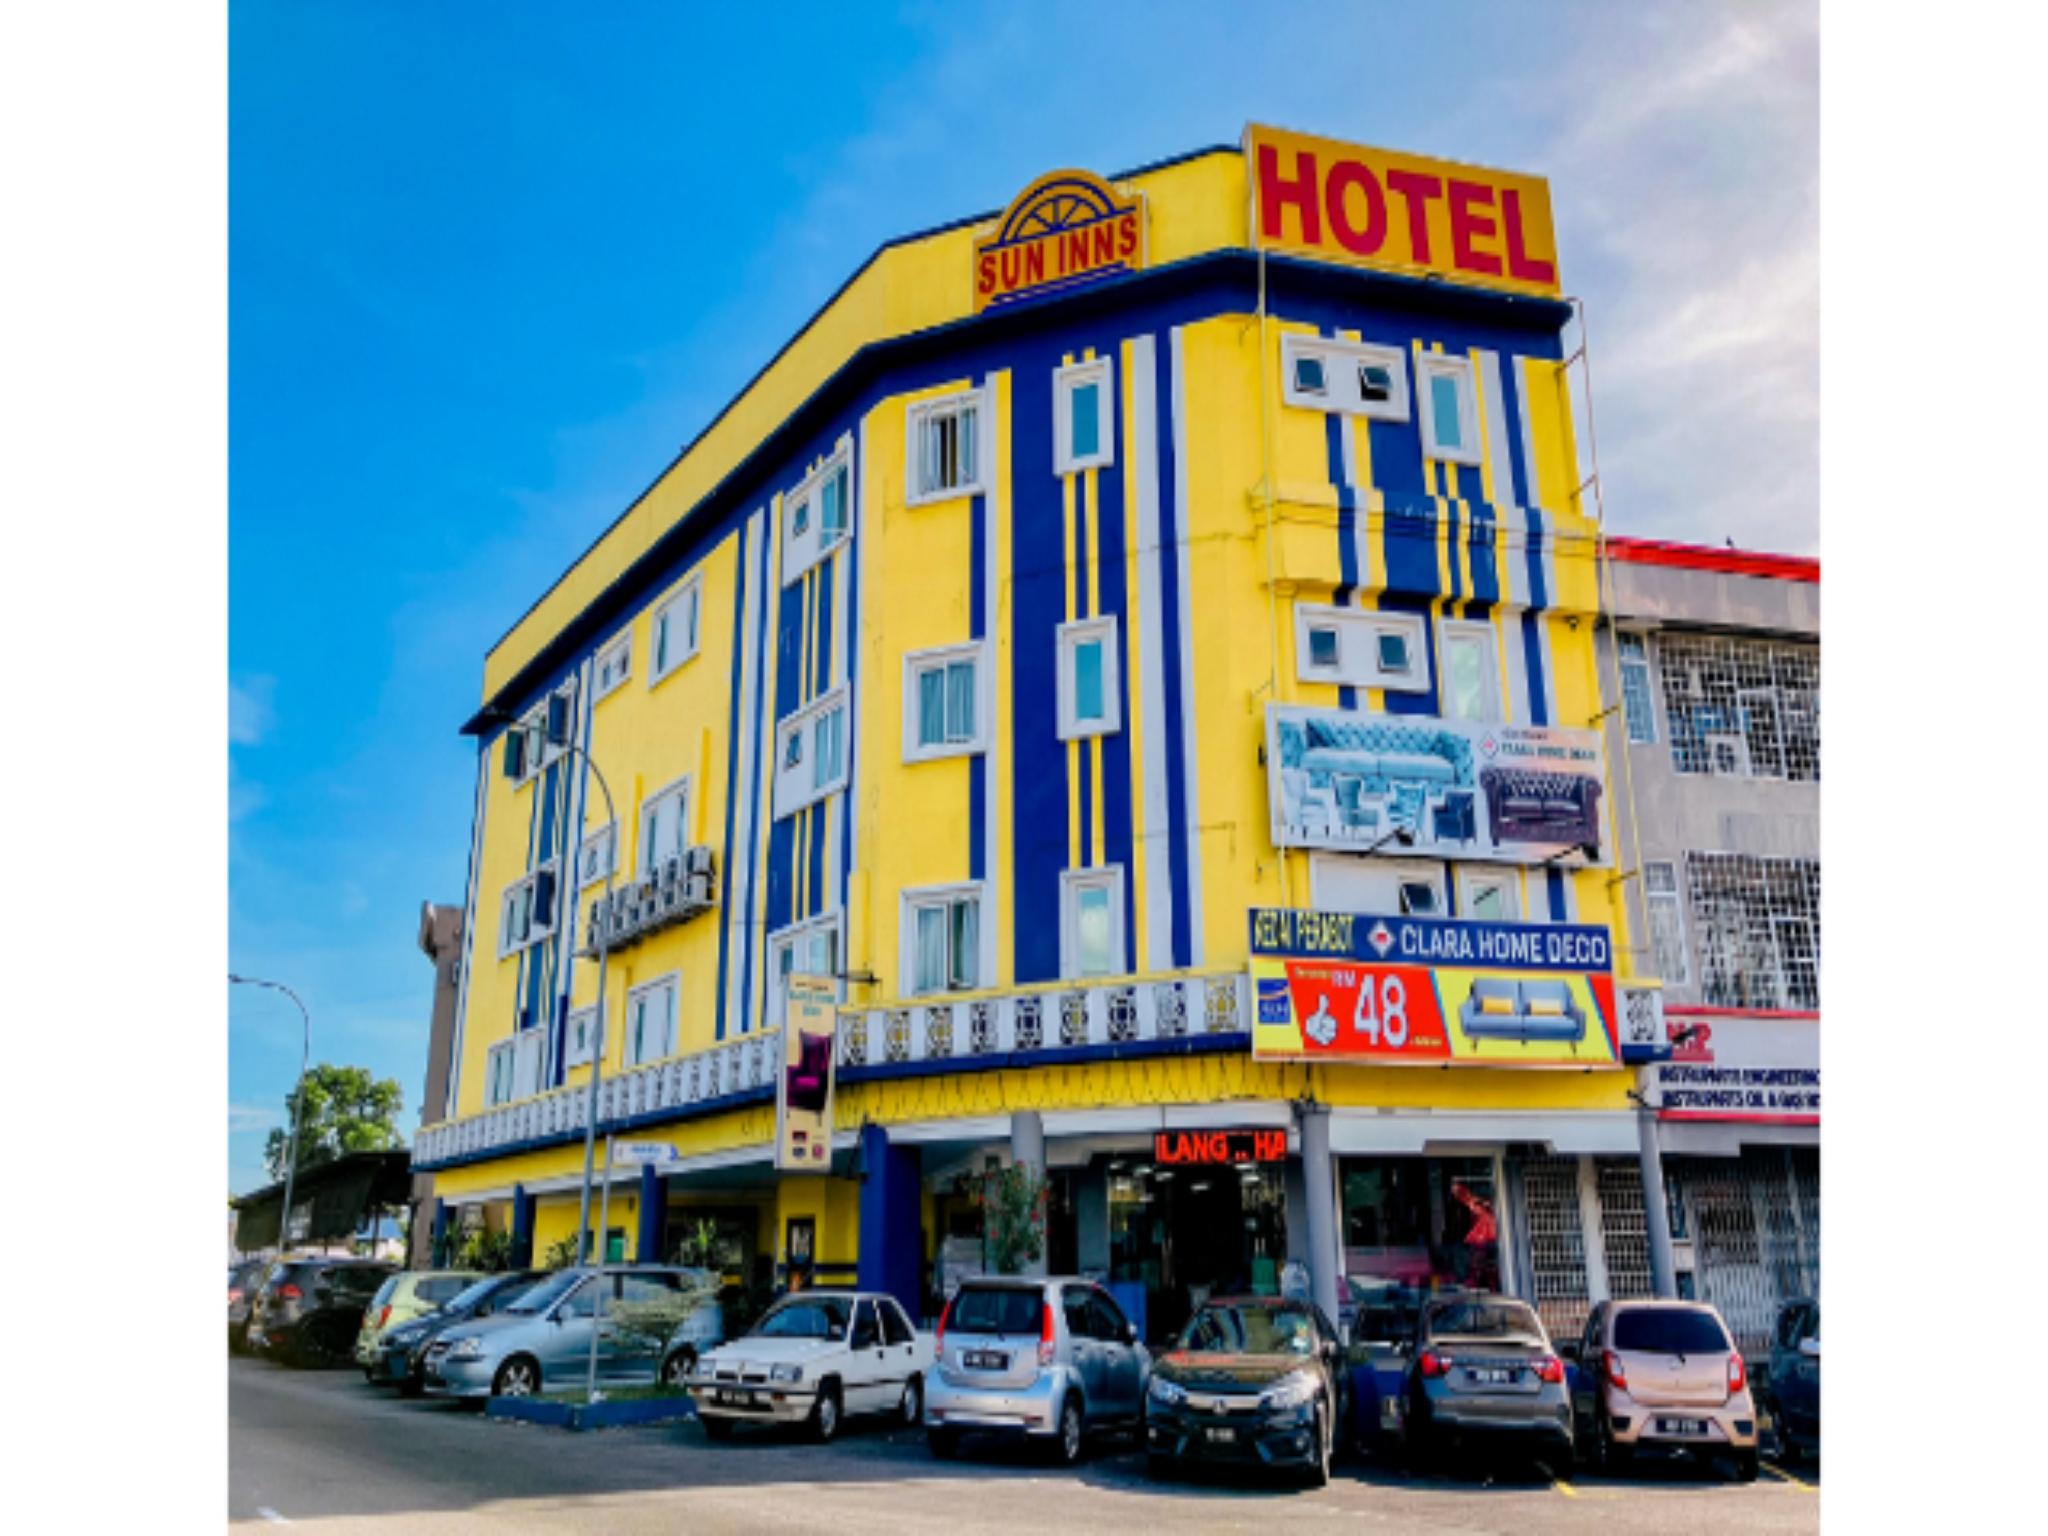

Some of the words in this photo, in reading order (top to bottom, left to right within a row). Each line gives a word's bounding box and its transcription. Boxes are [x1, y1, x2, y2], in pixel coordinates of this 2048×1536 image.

[978, 237, 1044, 294] SUN
[1059, 213, 1137, 274] INNS
[1258, 144, 1555, 284] HOTEL
[1401, 923, 1474, 960] CLARA
[1479, 928, 1544, 963] HOME
[1547, 932, 1607, 964] DECO
[1332, 970, 1357, 988] RM
[1354, 973, 1408, 1048] 48
